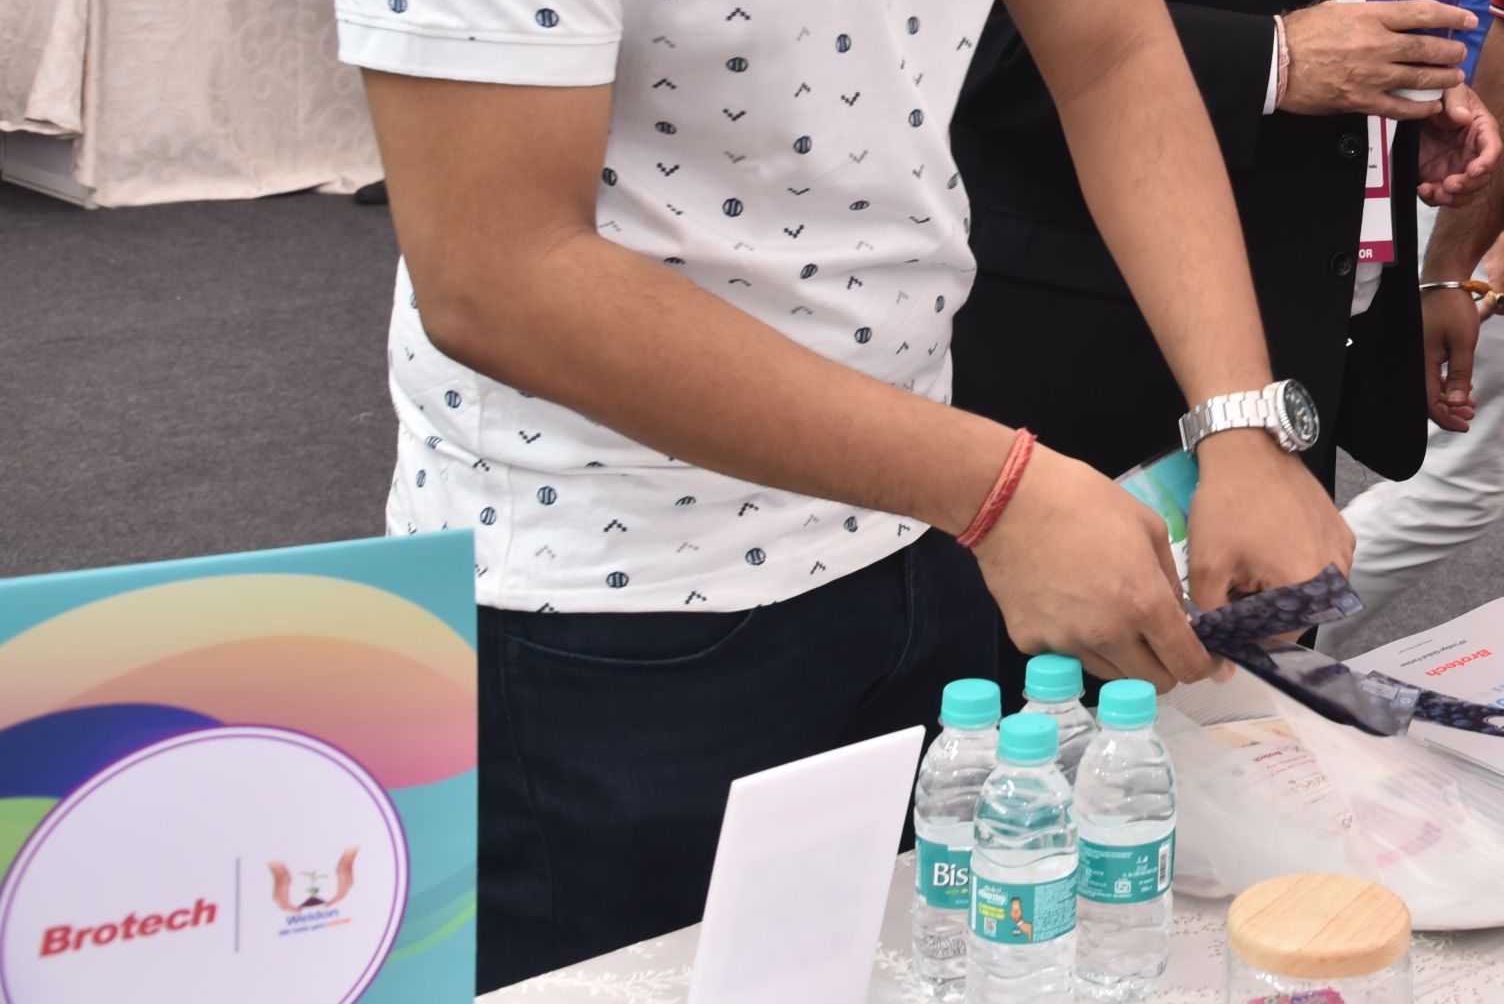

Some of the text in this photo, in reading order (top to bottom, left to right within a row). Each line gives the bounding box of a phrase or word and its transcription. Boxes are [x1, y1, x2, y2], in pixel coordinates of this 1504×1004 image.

[1358, 248, 1373, 259] OR
[1426, 648, 1493, 677] Brotech
[933, 862, 970, 886] Bis
[39, 897, 218, 958] Brotech
